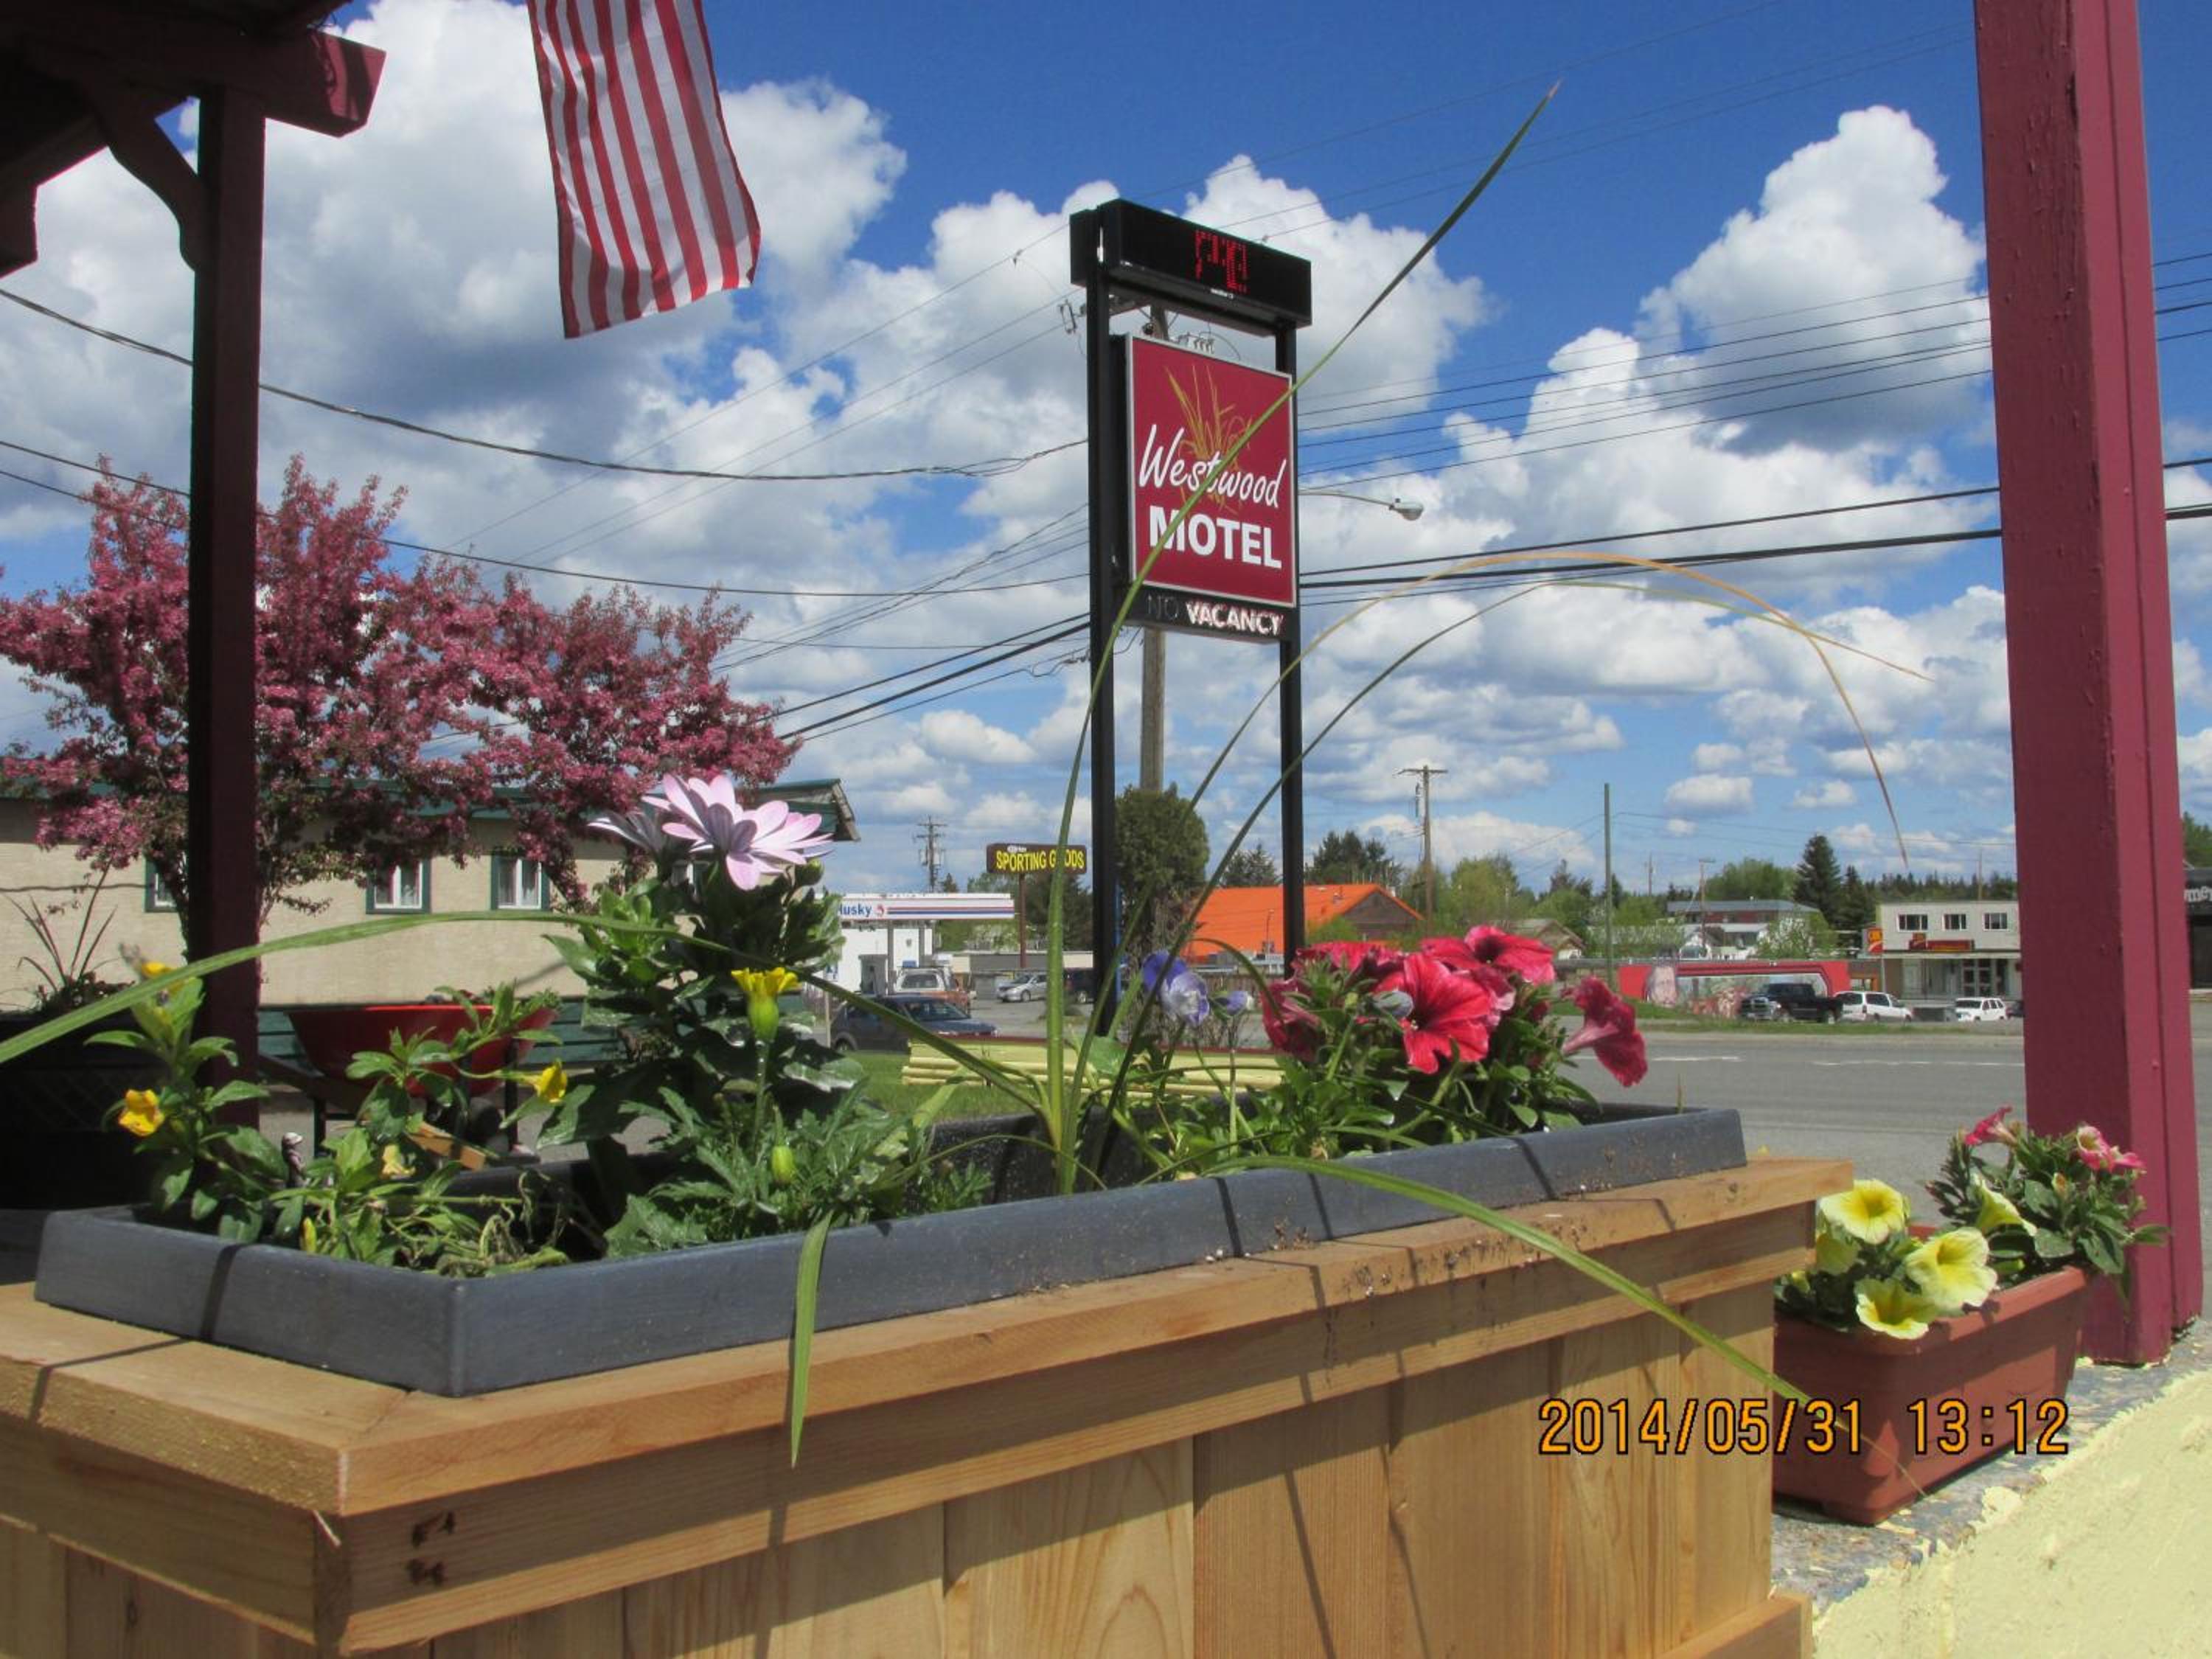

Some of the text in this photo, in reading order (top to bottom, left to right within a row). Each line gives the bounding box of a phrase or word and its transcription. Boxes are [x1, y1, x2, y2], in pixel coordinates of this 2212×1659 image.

[1138, 424, 1287, 509] Westwood
[1150, 504, 1282, 569] MOTEL
[1186, 599, 1284, 636] VACANCY
[996, 849, 1046, 871] SPORTING
[1049, 849, 1085, 869] GODS
